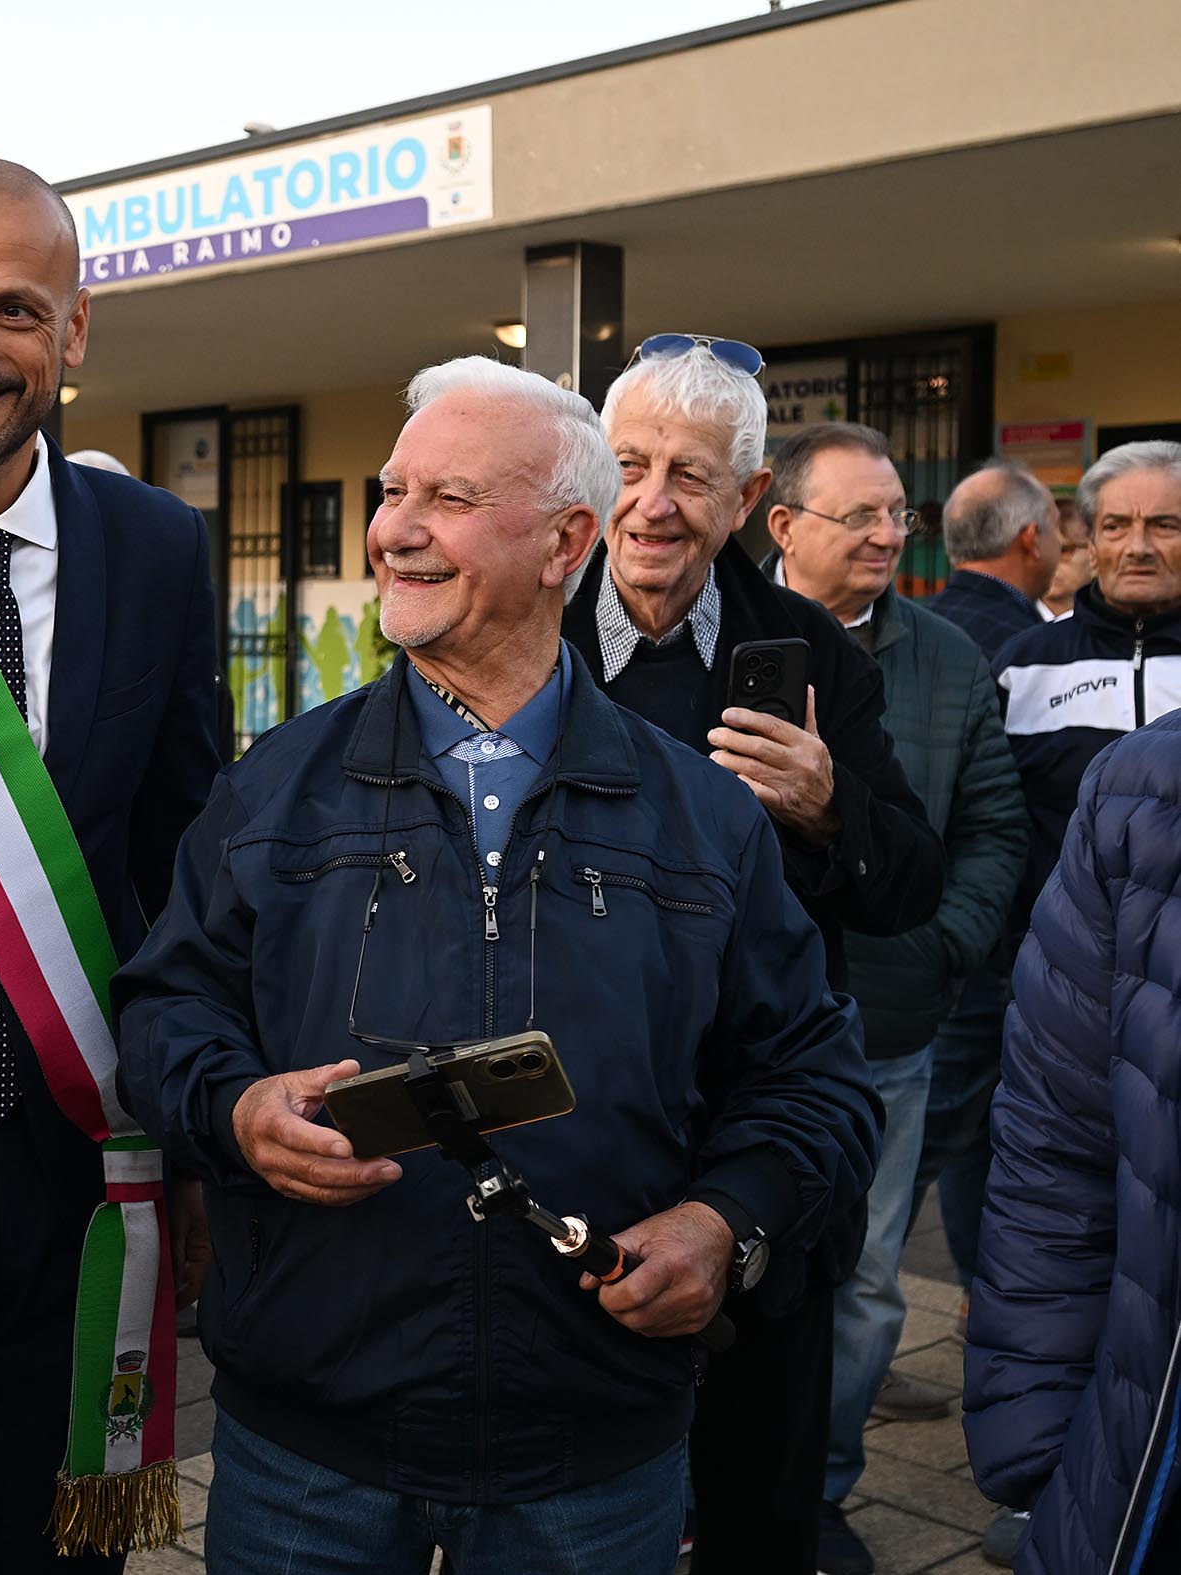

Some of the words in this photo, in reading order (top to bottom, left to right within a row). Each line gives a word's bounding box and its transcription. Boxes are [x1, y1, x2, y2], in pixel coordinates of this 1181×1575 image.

[84, 138, 427, 249] MBULATORIO
[172, 222, 292, 266] RAIMO
[1050, 676, 1118, 709] GIVOVA
